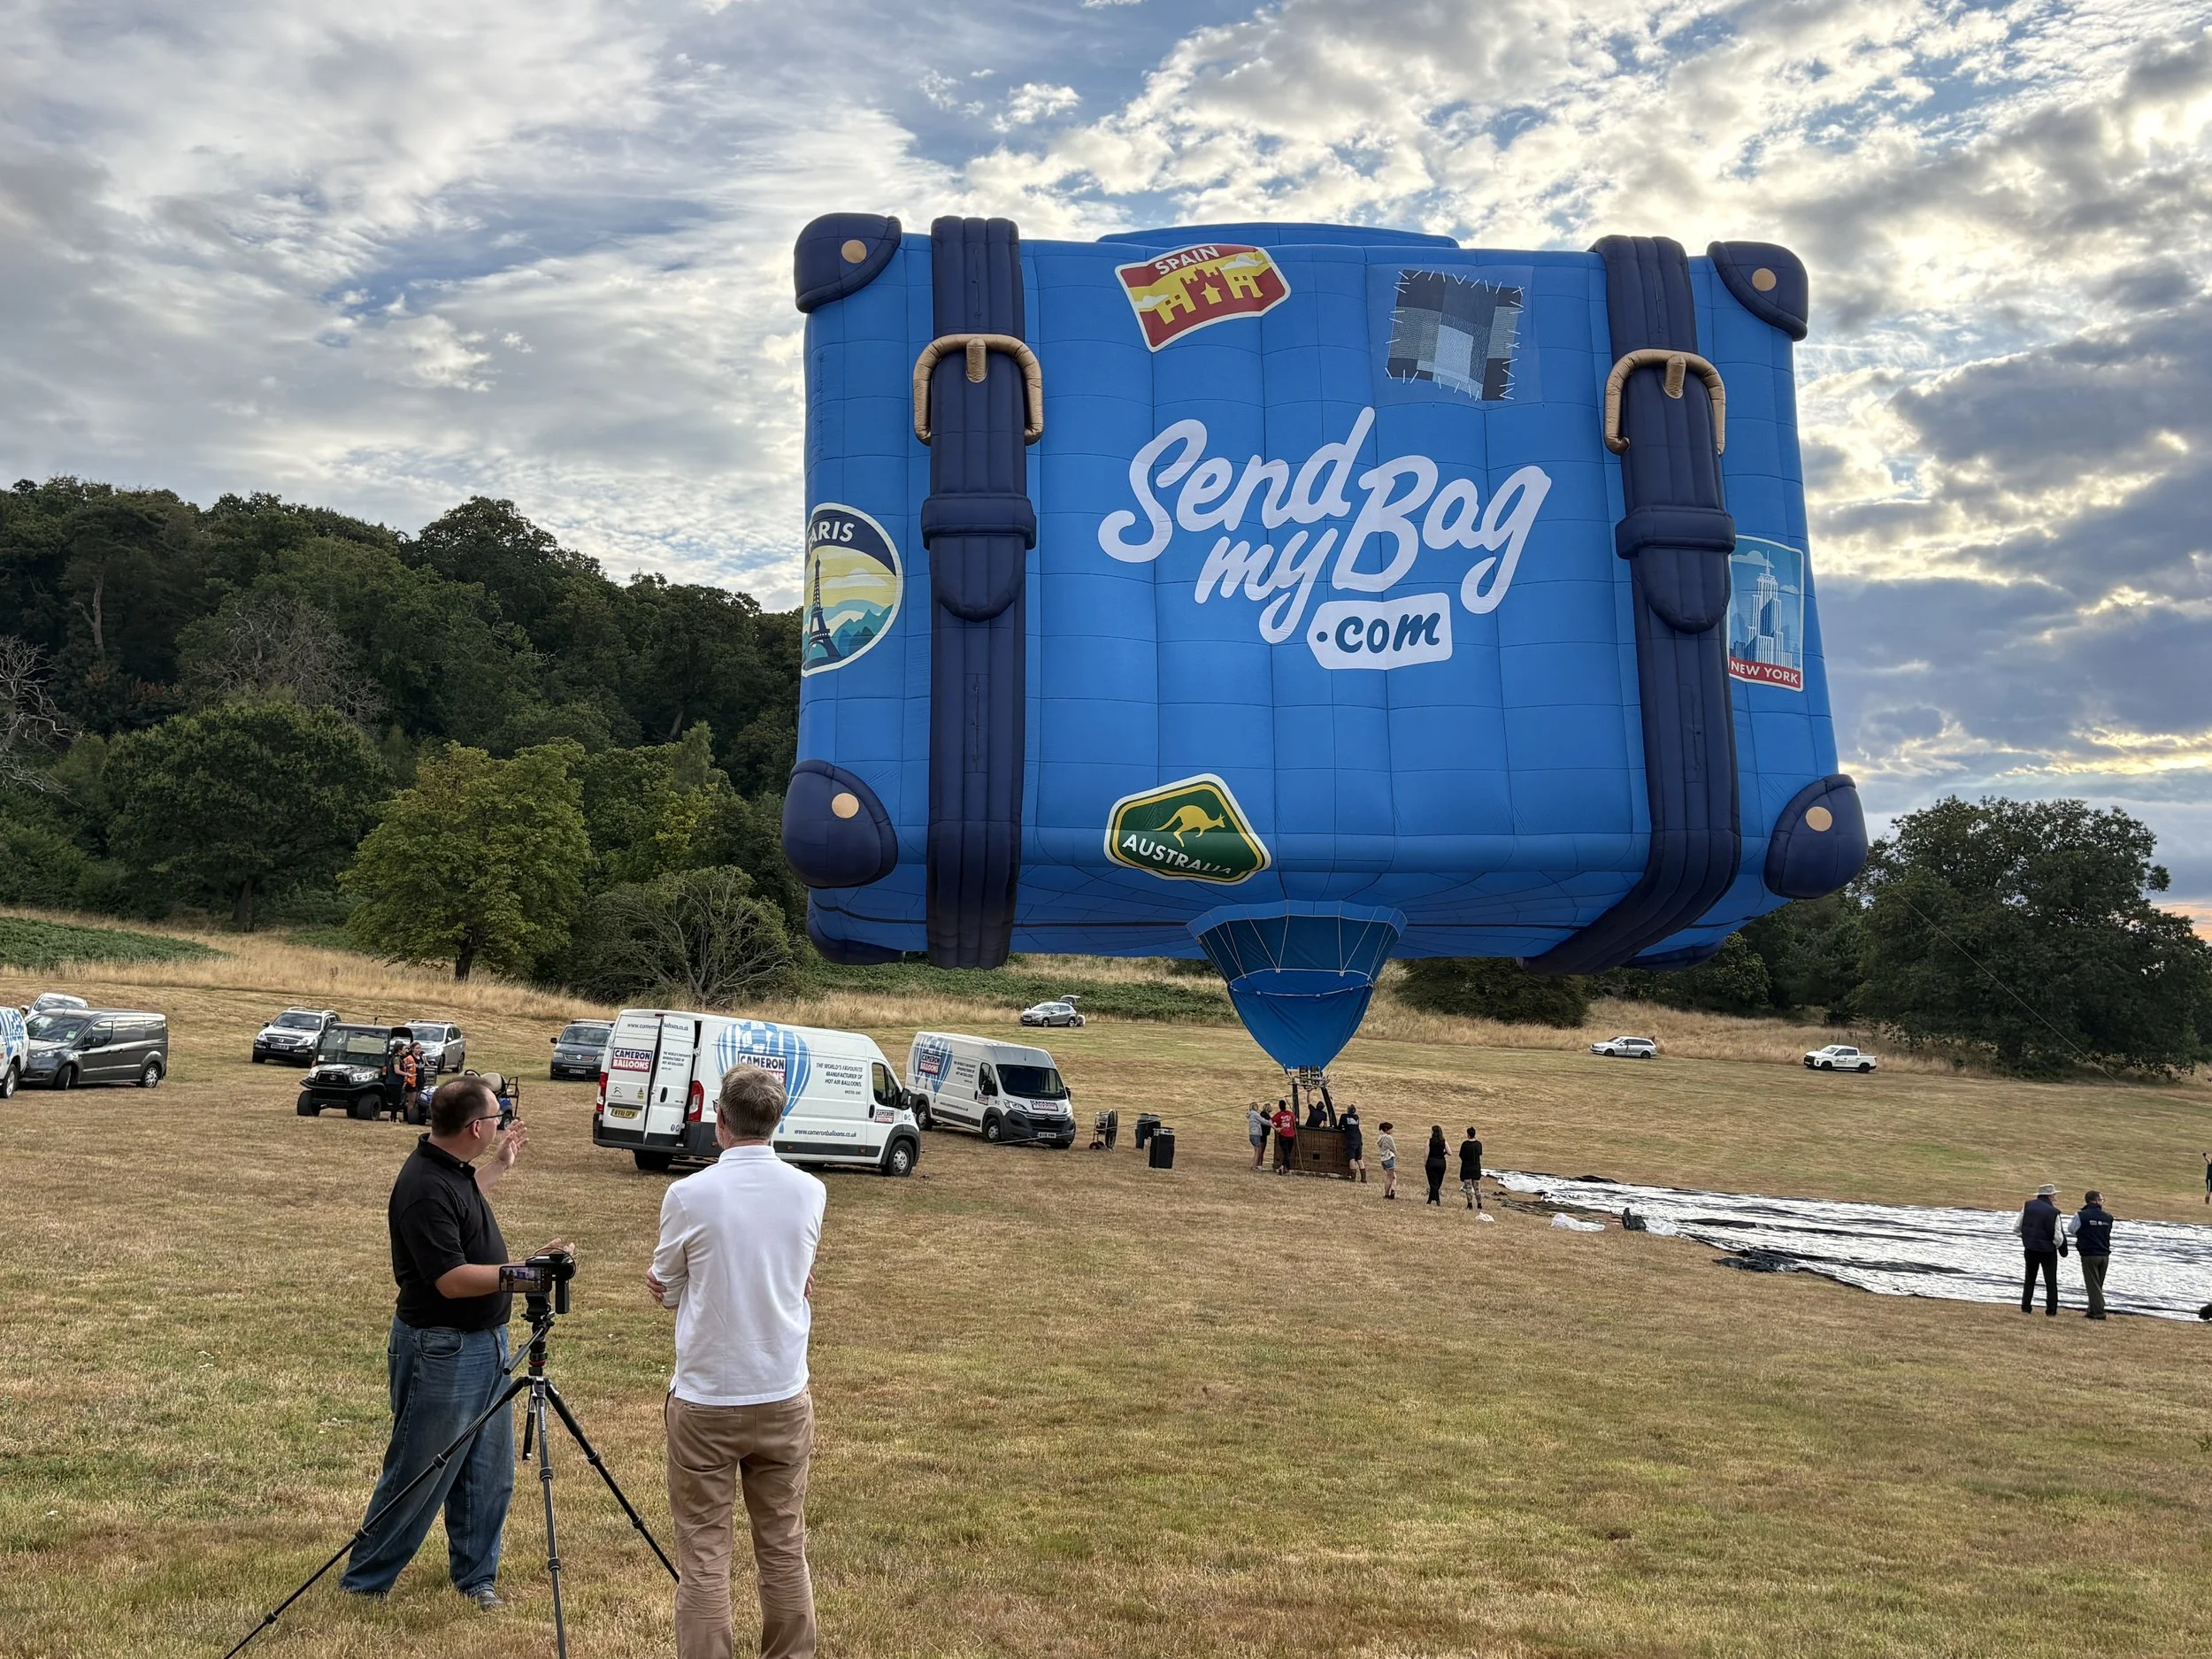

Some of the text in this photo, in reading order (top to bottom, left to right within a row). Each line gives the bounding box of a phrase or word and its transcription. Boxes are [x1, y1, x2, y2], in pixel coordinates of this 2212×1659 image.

[1155, 246, 1220, 275] SPAIN
[1098, 406, 1376, 564] Send
[1194, 454, 1553, 644] my Bag
[1317, 611, 1441, 654] .com
[1730, 659, 1799, 684] NEW YORK
[1122, 833, 1232, 874] AUSTRALIA
[612, 1058, 649, 1070] BALLOONS
[614, 1049, 650, 1060] CAMERON
[740, 1055, 784, 1070] CAMERON
